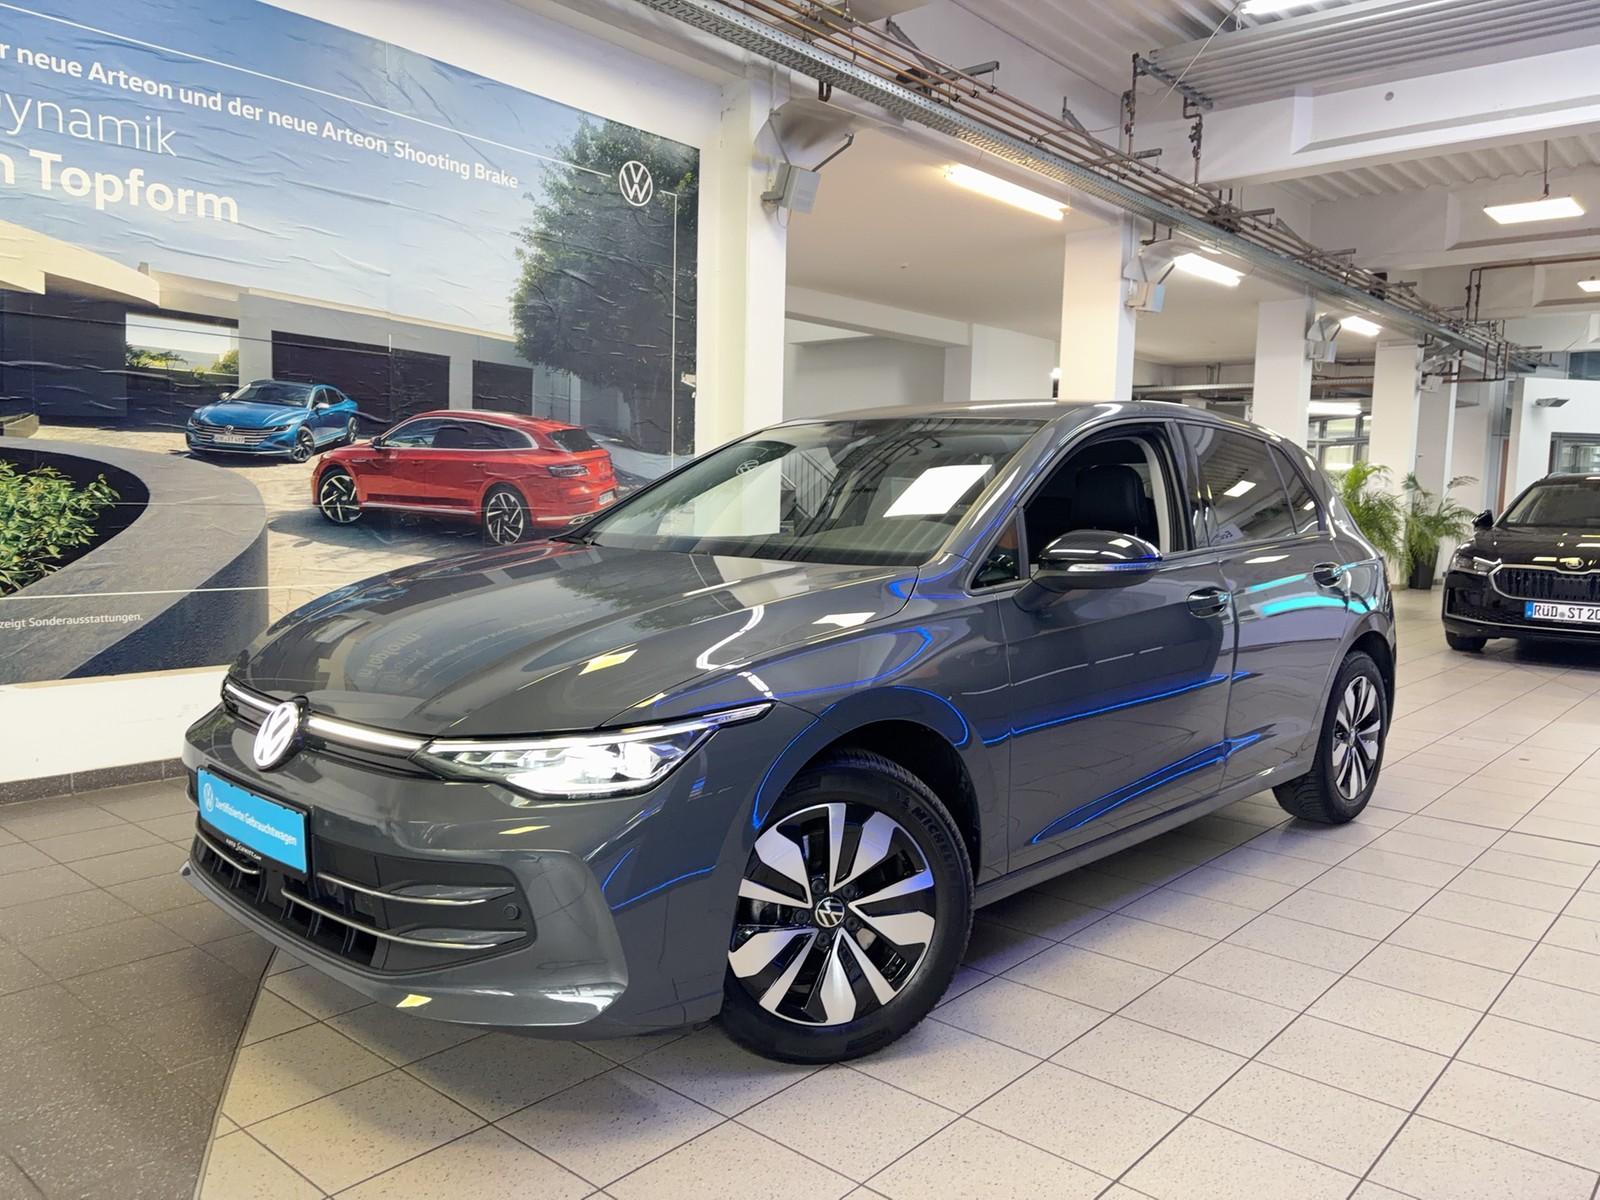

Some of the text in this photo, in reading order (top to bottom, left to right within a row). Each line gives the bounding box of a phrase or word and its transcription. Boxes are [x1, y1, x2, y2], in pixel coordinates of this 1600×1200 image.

[0, 93, 176, 157] ynamik
[16, 47, 82, 78] neue
[88, 61, 173, 100] Arteon
[179, 87, 222, 112] und
[227, 96, 263, 121] der
[268, 110, 317, 136] neue
[321, 121, 388, 154] Arteon
[393, 140, 470, 181] Shooting
[474, 162, 519, 189] Brake
[28, 149, 239, 224] Topform
[0, 614, 143, 630] zeigt Sonderausstattungen.
[1534, 605, 1558, 617] RÜD
[1568, 608, 1584, 619] ST
